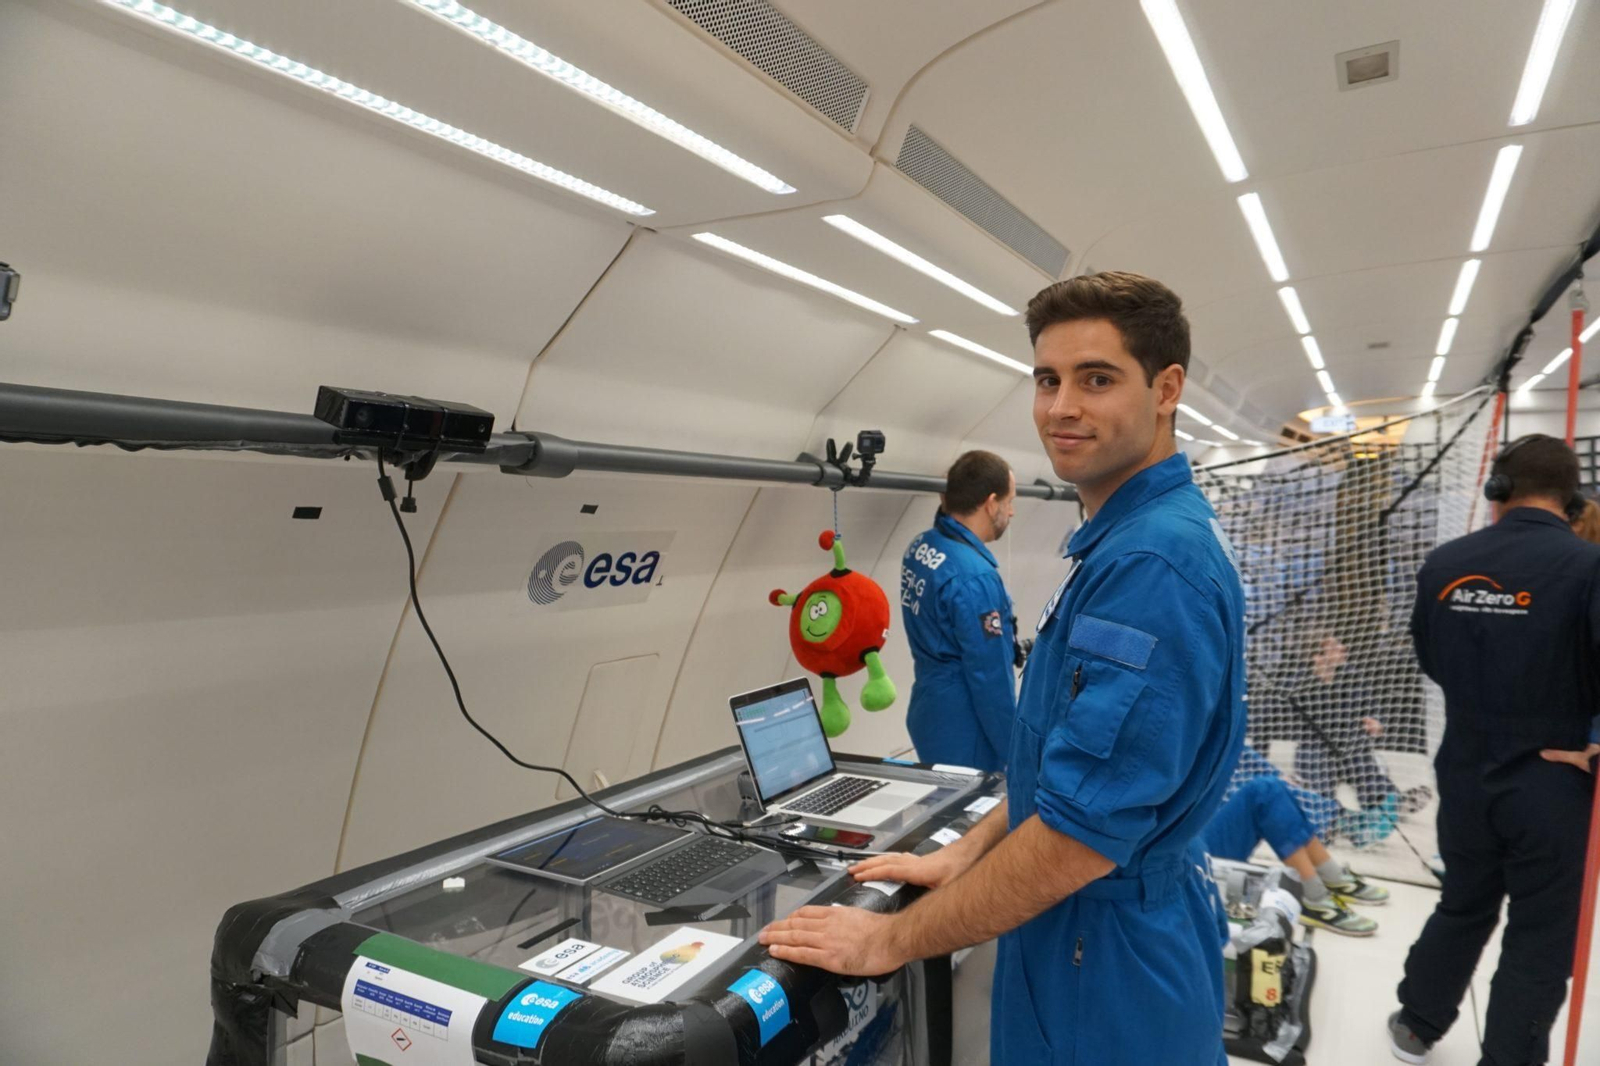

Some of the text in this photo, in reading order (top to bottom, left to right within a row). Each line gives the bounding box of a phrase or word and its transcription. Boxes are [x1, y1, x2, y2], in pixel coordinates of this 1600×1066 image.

[915, 543, 946, 570] esa
[583, 550, 660, 589] esa
[555, 944, 585, 959] esa
[622, 967, 648, 984] GROUP
[638, 967, 670, 988] SCIENCE
[761, 979, 776, 996] esa
[534, 996, 560, 1009] esa
[762, 998, 785, 1022] education
[508, 1011, 544, 1025] education
